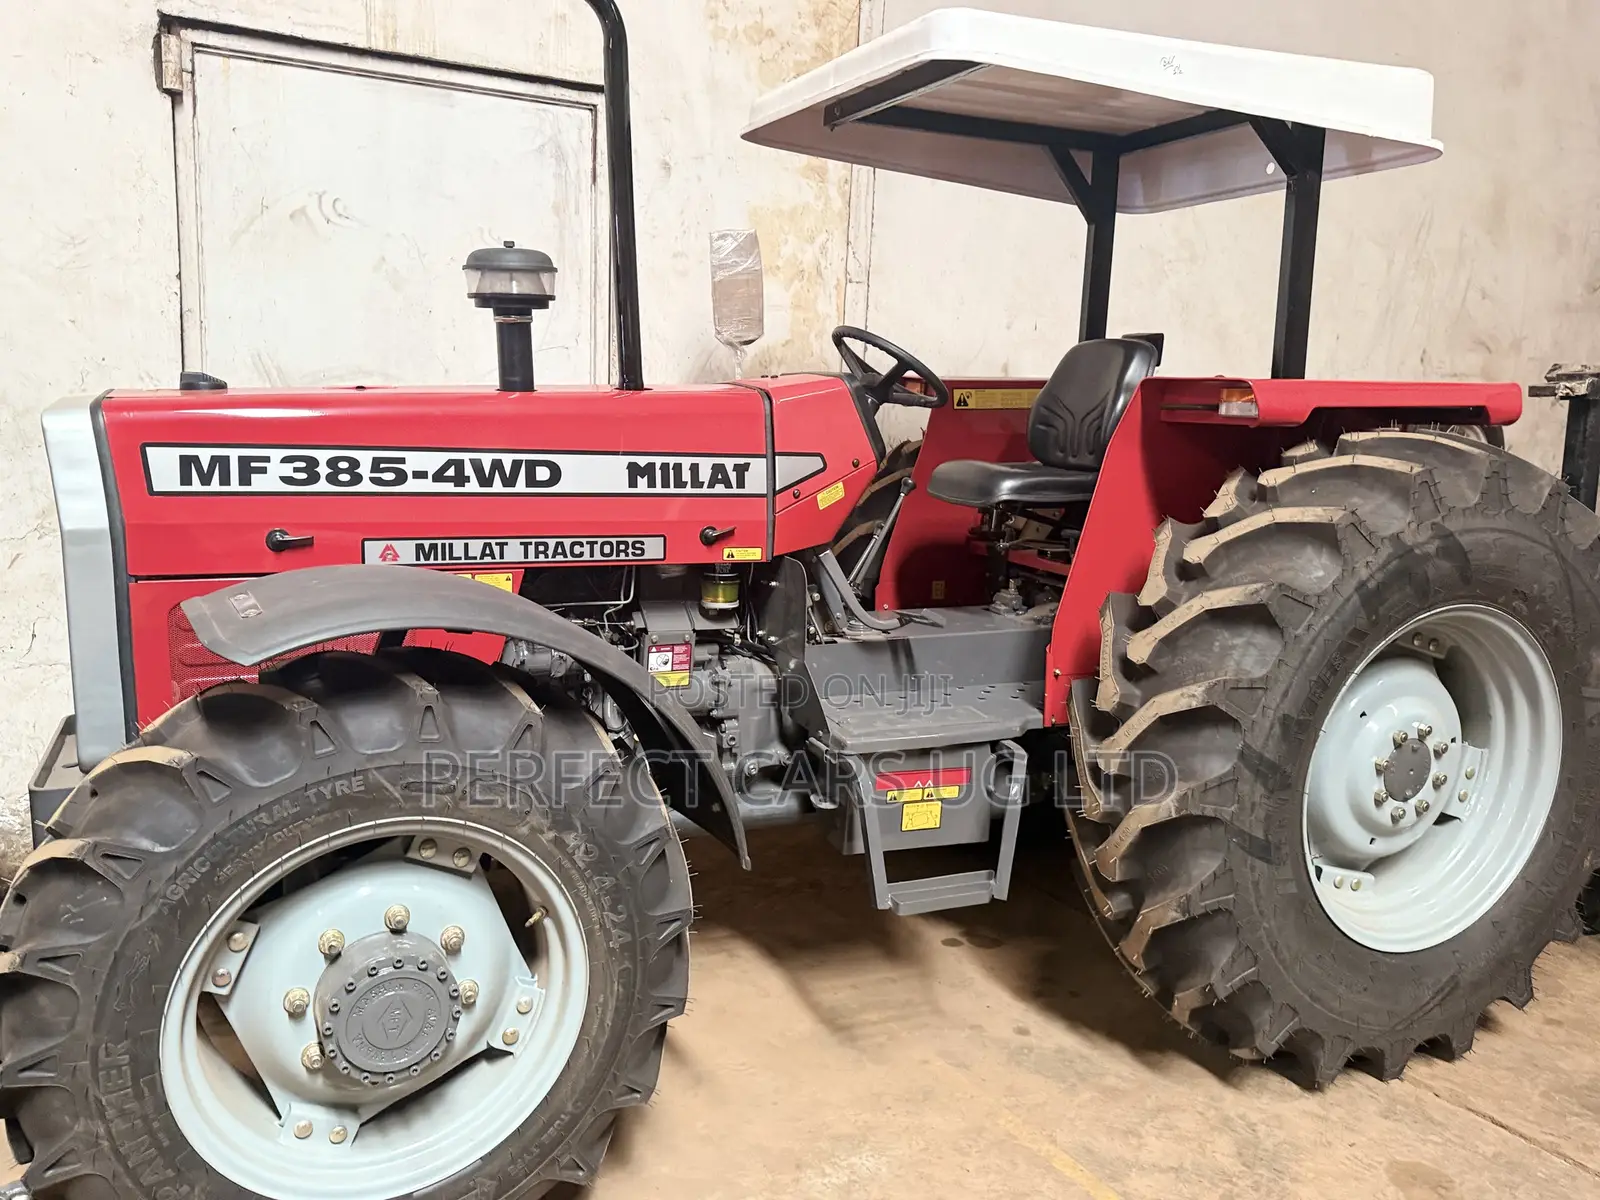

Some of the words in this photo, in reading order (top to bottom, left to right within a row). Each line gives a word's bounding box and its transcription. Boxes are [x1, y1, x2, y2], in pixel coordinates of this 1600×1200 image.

[626, 461, 750, 489] MILLAT
[415, 541, 508, 562] MILLAT
[519, 540, 646, 560] TRACTORS
[303, 775, 366, 804] TYRE
